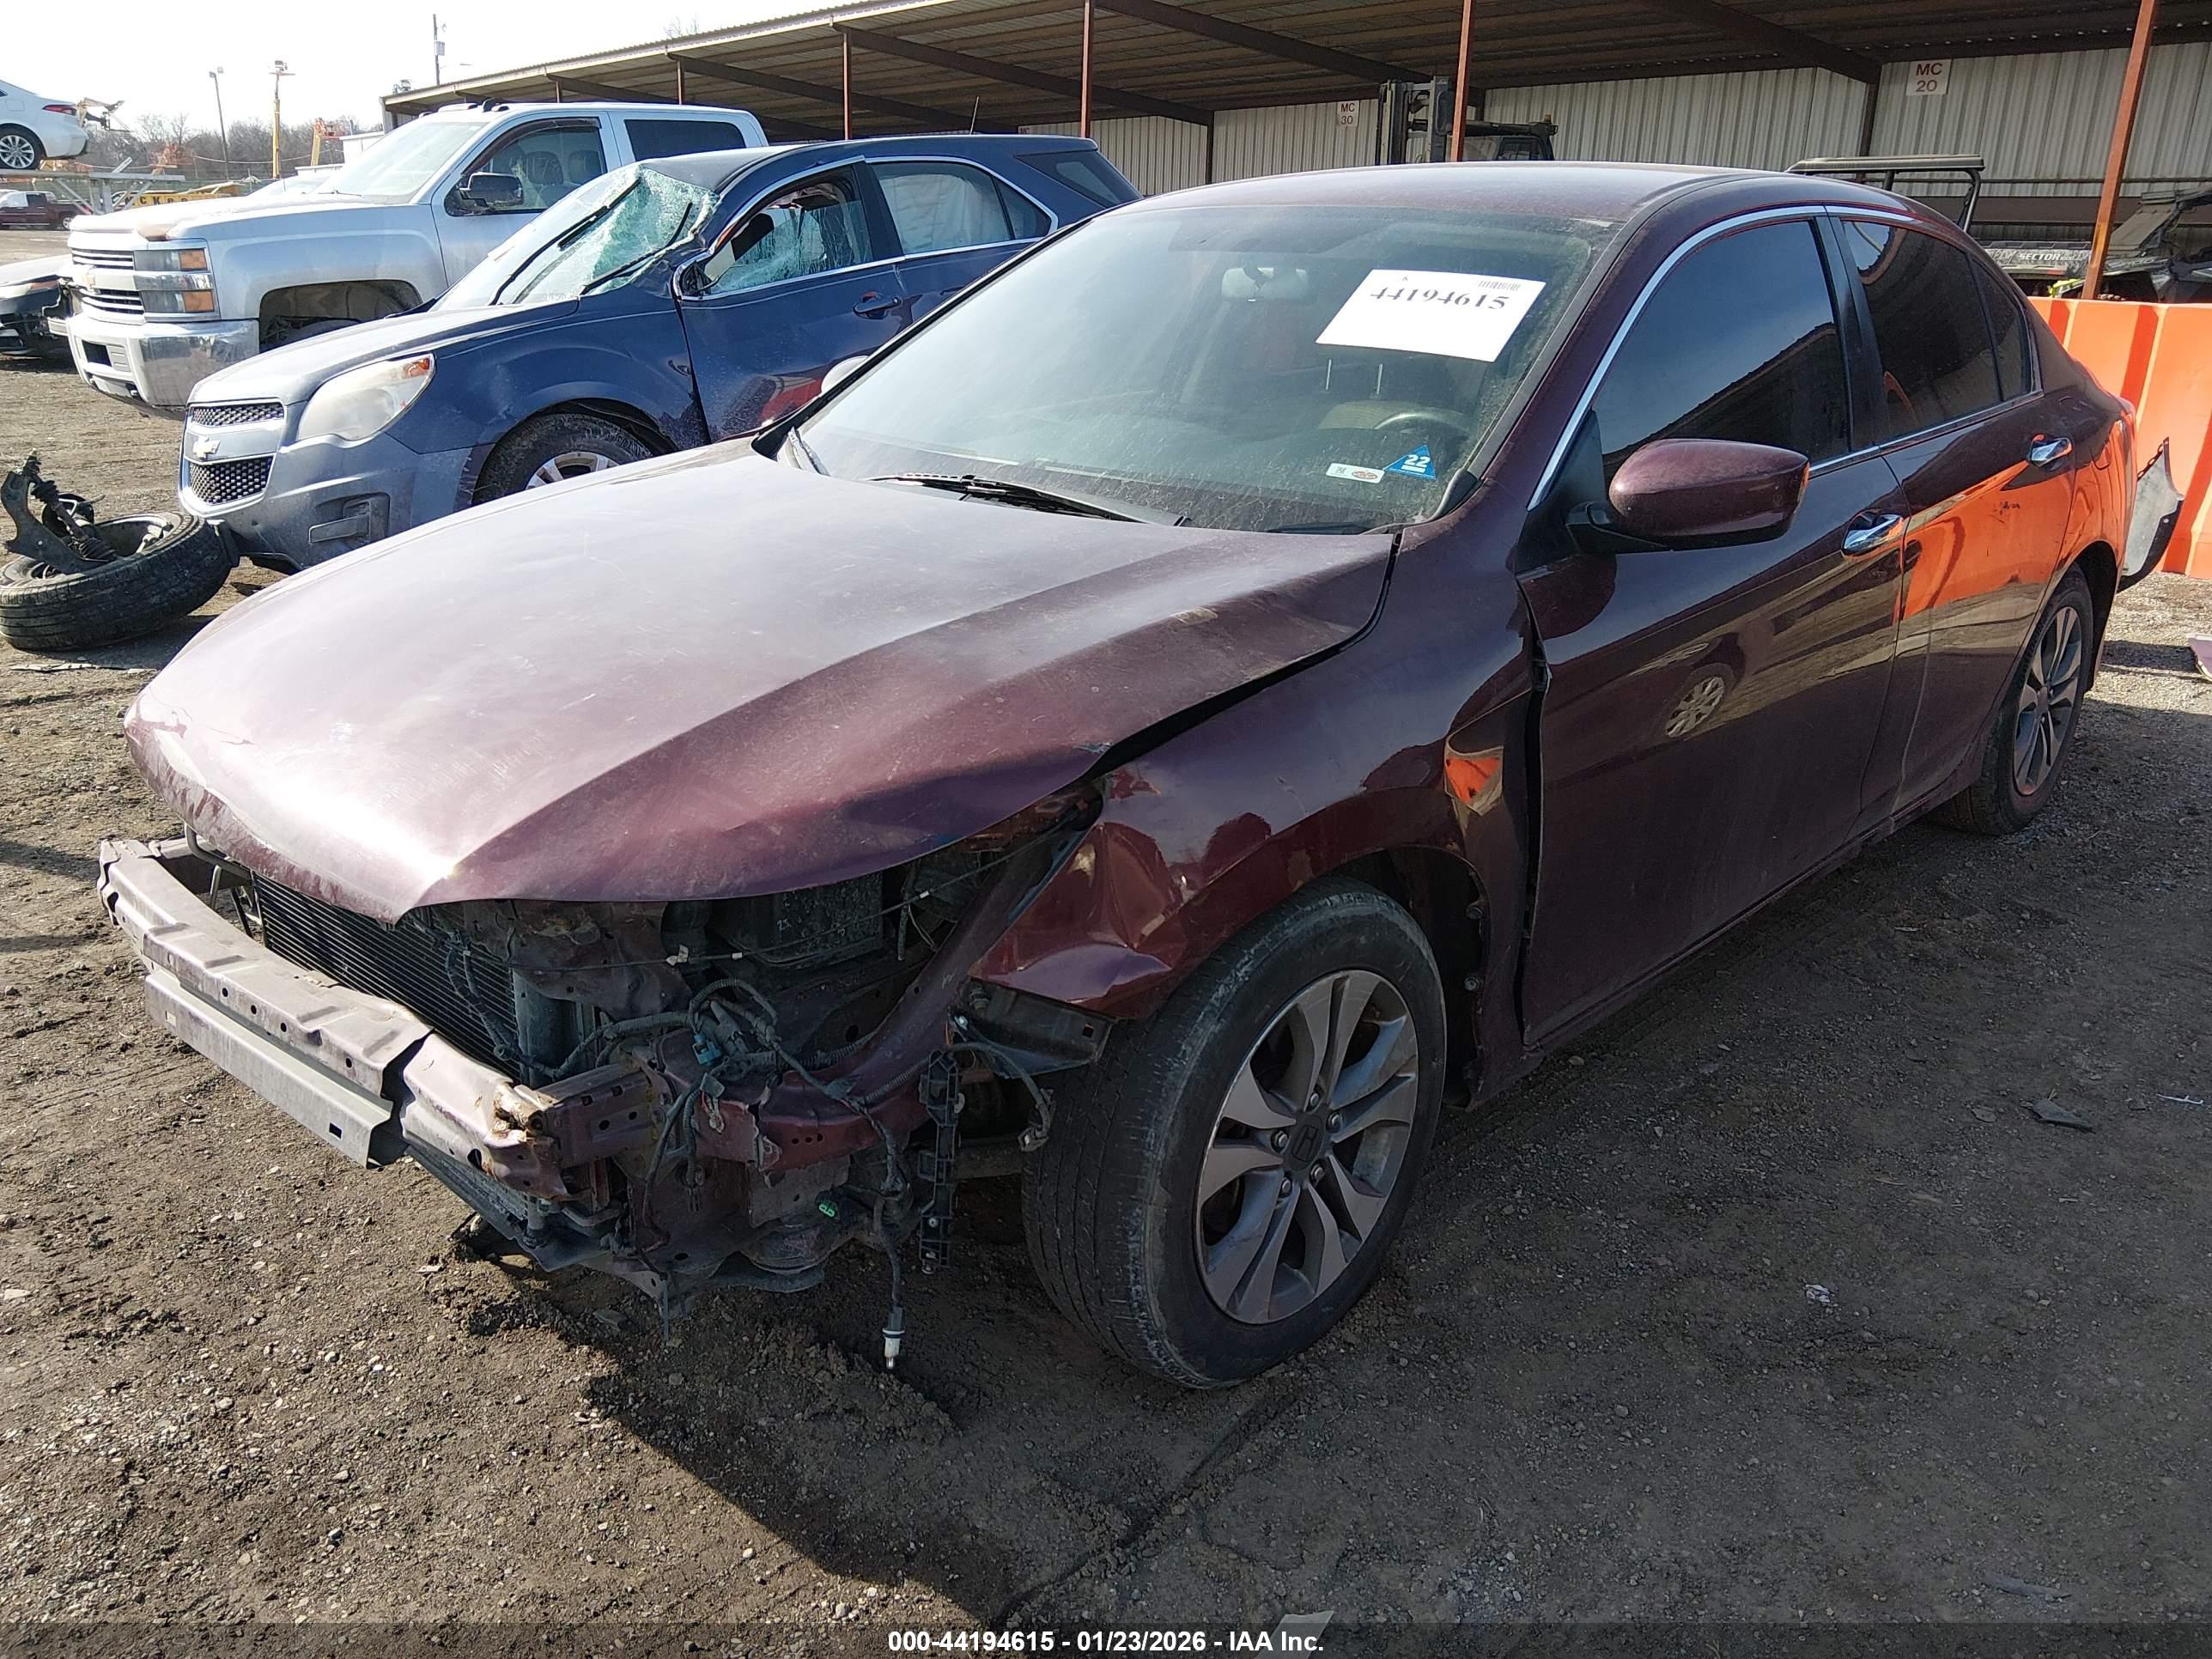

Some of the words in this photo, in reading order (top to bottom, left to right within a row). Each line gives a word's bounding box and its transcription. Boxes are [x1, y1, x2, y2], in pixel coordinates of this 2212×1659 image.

[1916, 63, 1942, 76] MC
[1916, 79, 1938, 92] 20
[1340, 103, 1355, 112] MC
[1341, 115, 1353, 125] 30
[1370, 287, 1510, 309] 44194615
[1403, 454, 1431, 469] 22
